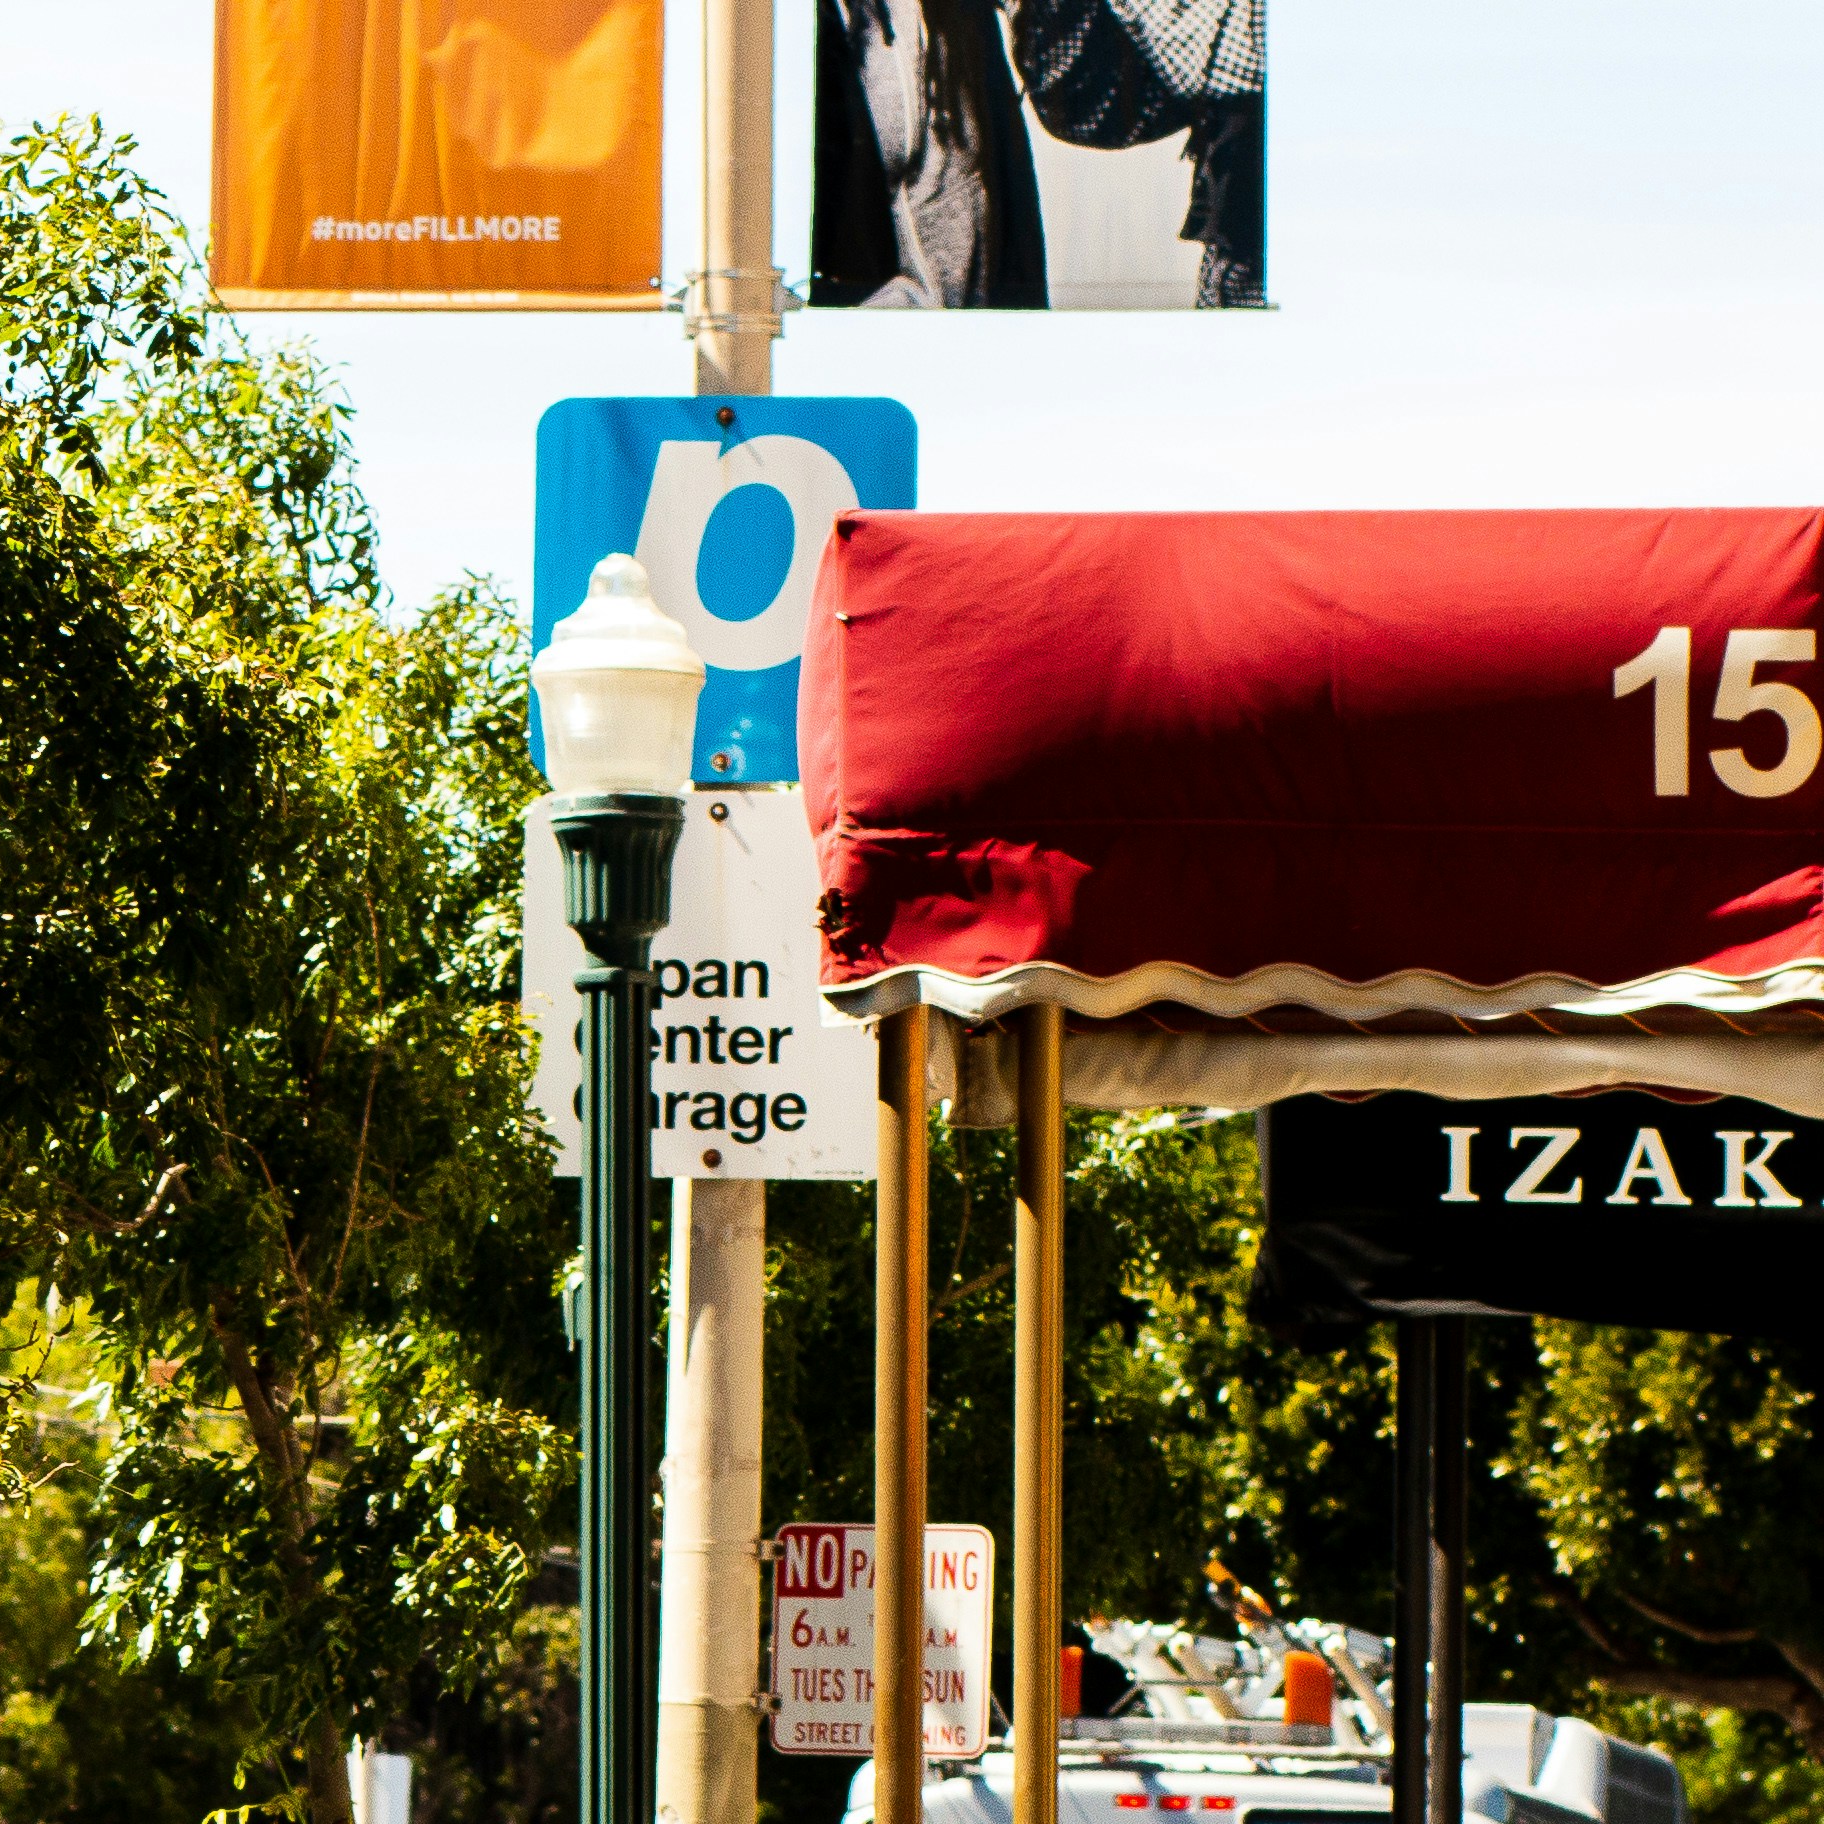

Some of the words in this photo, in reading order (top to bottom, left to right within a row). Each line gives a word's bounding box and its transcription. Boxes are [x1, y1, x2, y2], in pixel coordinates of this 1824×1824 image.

[311, 215, 562, 243] #moreFILLMORE
[651, 958, 770, 1010] pan
[1440, 1126, 1824, 1208] IZAK
[784, 1533, 837, 1590] NO
[851, 1550, 978, 1591] PING
[791, 1668, 845, 1703] TUES
[793, 1721, 862, 1745] STREET
